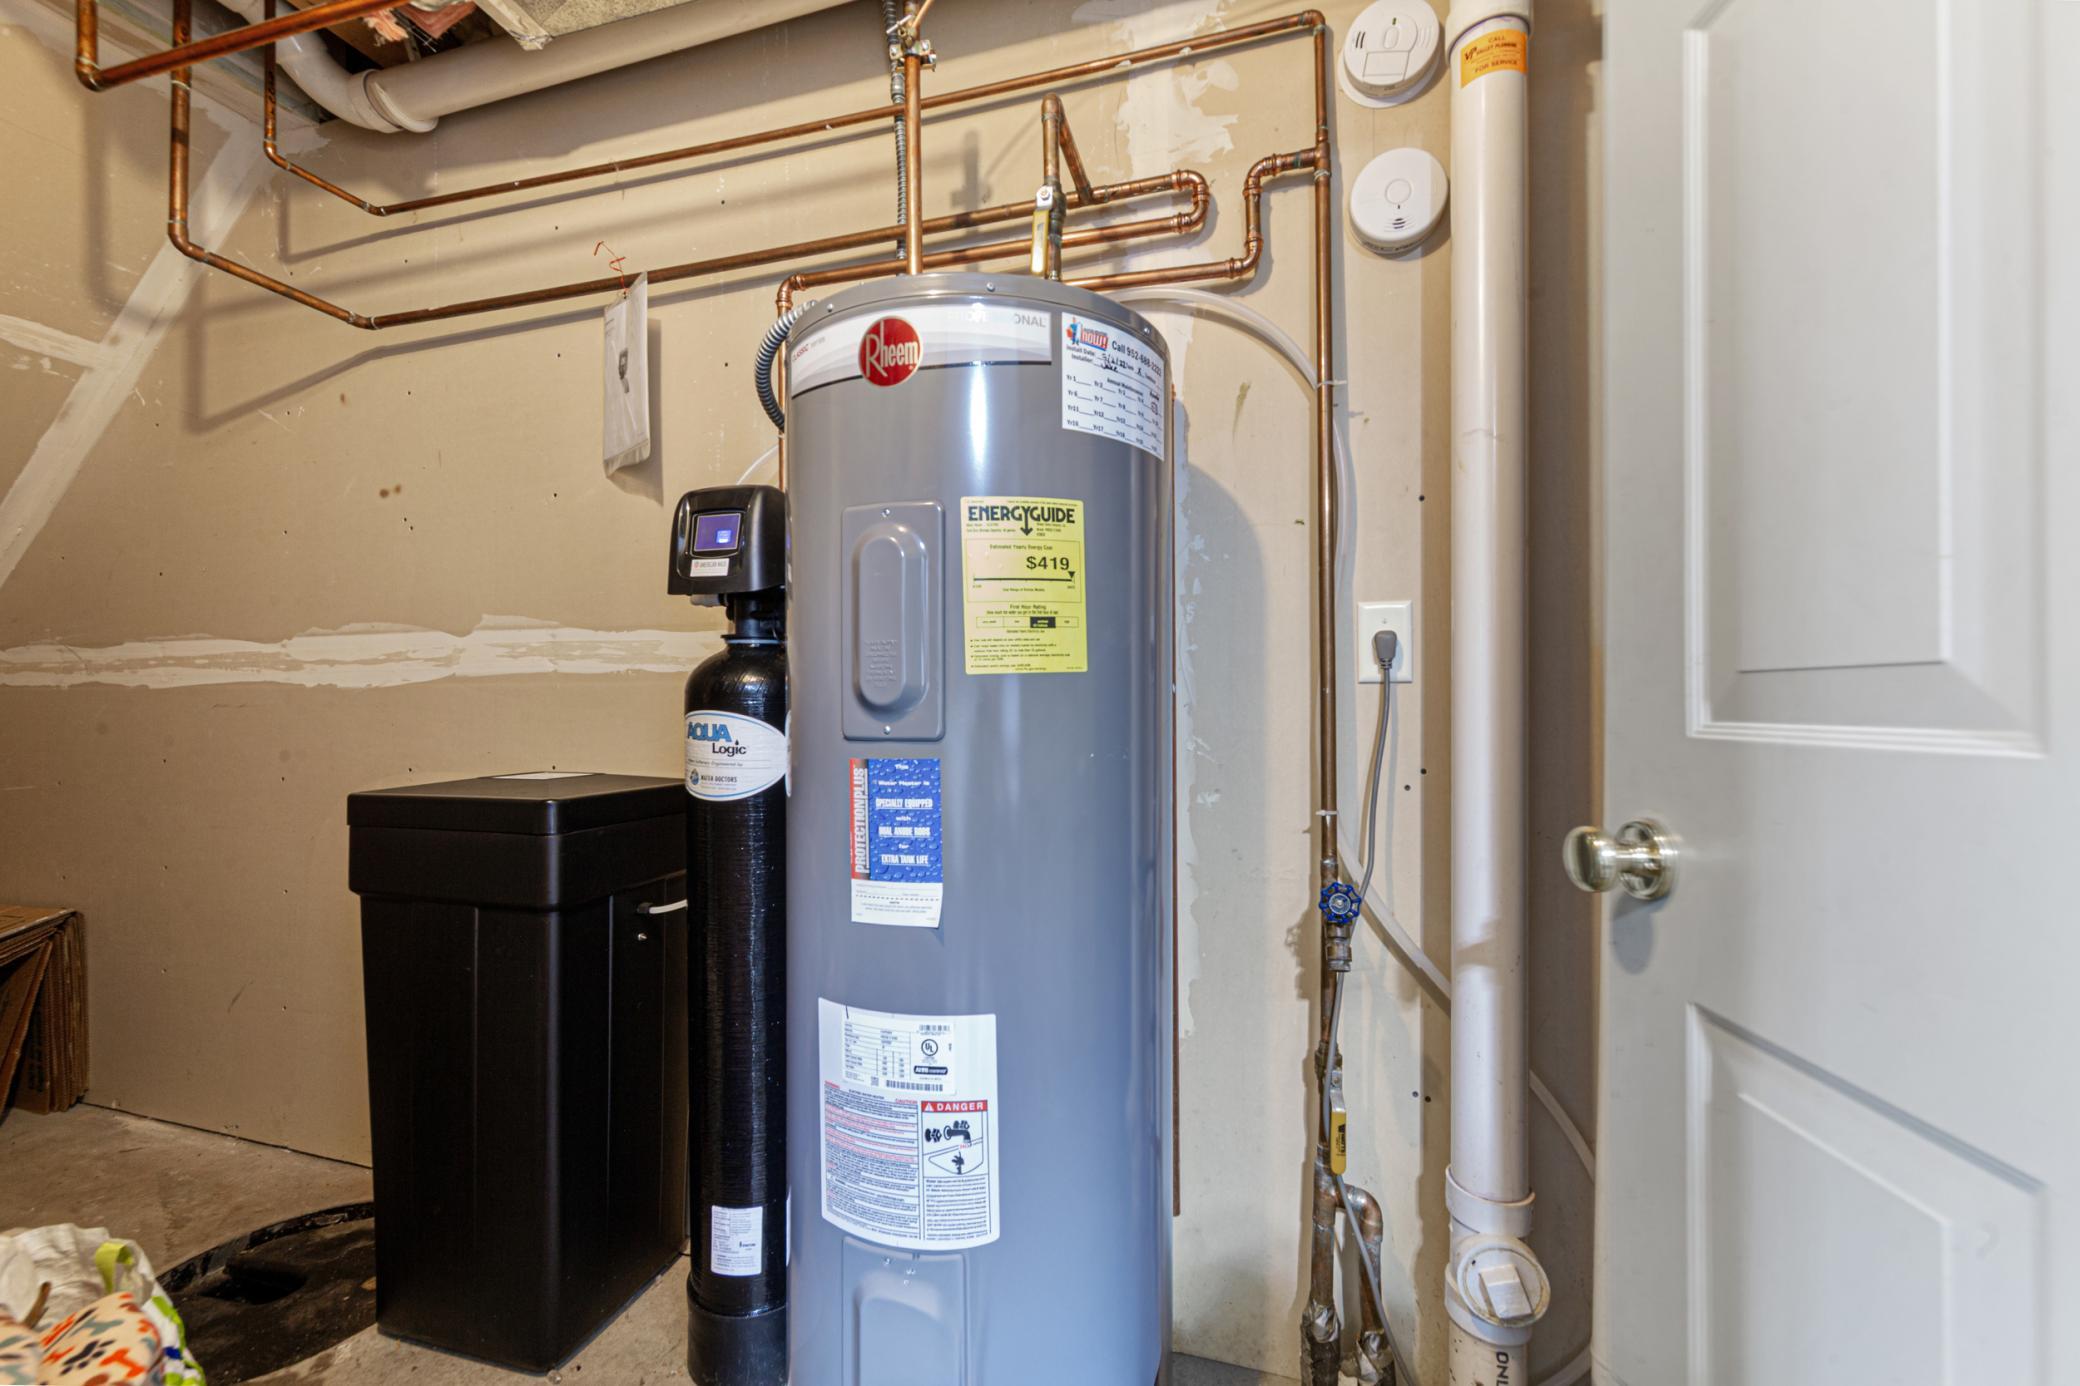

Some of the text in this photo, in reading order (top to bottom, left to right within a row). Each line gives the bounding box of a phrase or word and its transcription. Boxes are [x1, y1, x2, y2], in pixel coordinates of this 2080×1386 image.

[866, 320, 918, 377] Rheem
[1112, 341, 1125, 353] Call
[968, 506, 1075, 523] ENERGYGUIDE
[1026, 556, 1070, 571] $419
[688, 722, 732, 742] AQUA
[712, 740, 746, 757] Logic
[937, 1102, 983, 1111] DANGER
